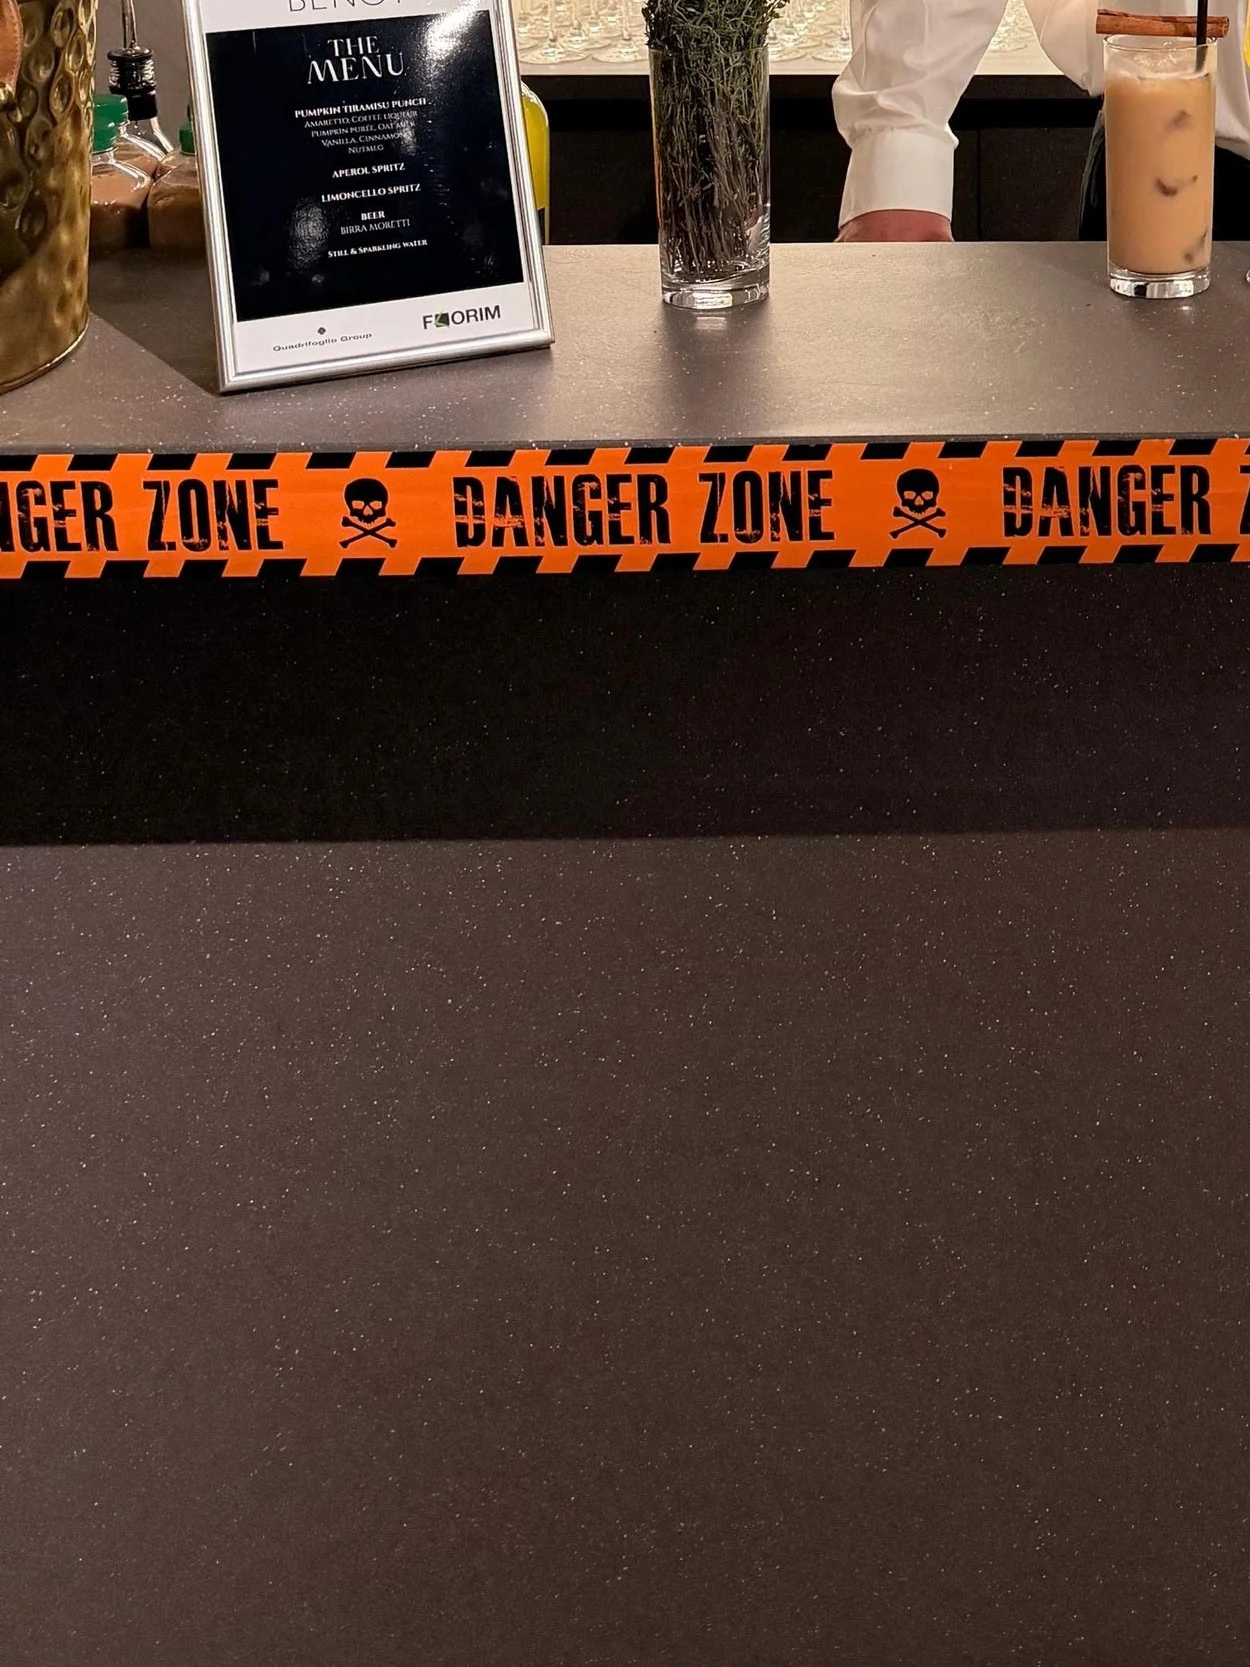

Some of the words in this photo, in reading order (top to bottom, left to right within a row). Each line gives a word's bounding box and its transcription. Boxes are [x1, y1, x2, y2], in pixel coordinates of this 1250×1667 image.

[327, 35, 380, 57] THE
[307, 52, 404, 84] MENU
[294, 106, 341, 119] PUMPKIN
[342, 100, 390, 114] TIRAMISU
[391, 97, 427, 109] PUNCH
[311, 126, 349, 138] PUMPKIN
[377, 123, 394, 131] OAT
[348, 144, 385, 154] NUTMEG
[332, 166, 371, 178] APEROL
[371, 162, 406, 174] SPRITZ
[321, 187, 387, 202] LIMONCELLO
[387, 183, 421, 195] SPRITZ
[360, 210, 386, 221] BEER
[340, 223, 368, 235] BIRRA
[368, 218, 411, 232] MORETTI
[327, 248, 350, 258] STILL
[349, 247, 358, 255] &
[358, 242, 402, 254] SPARKLING
[402, 238, 428, 248] WATER
[272, 335, 338, 353] Quadrifoglio
[339, 332, 373, 344] Group
[143, 478, 284, 552] ZONE
[453, 472, 672, 549] DANGER
[697, 469, 836, 545] ZONE
[1002, 462, 1212, 538] DANGER
